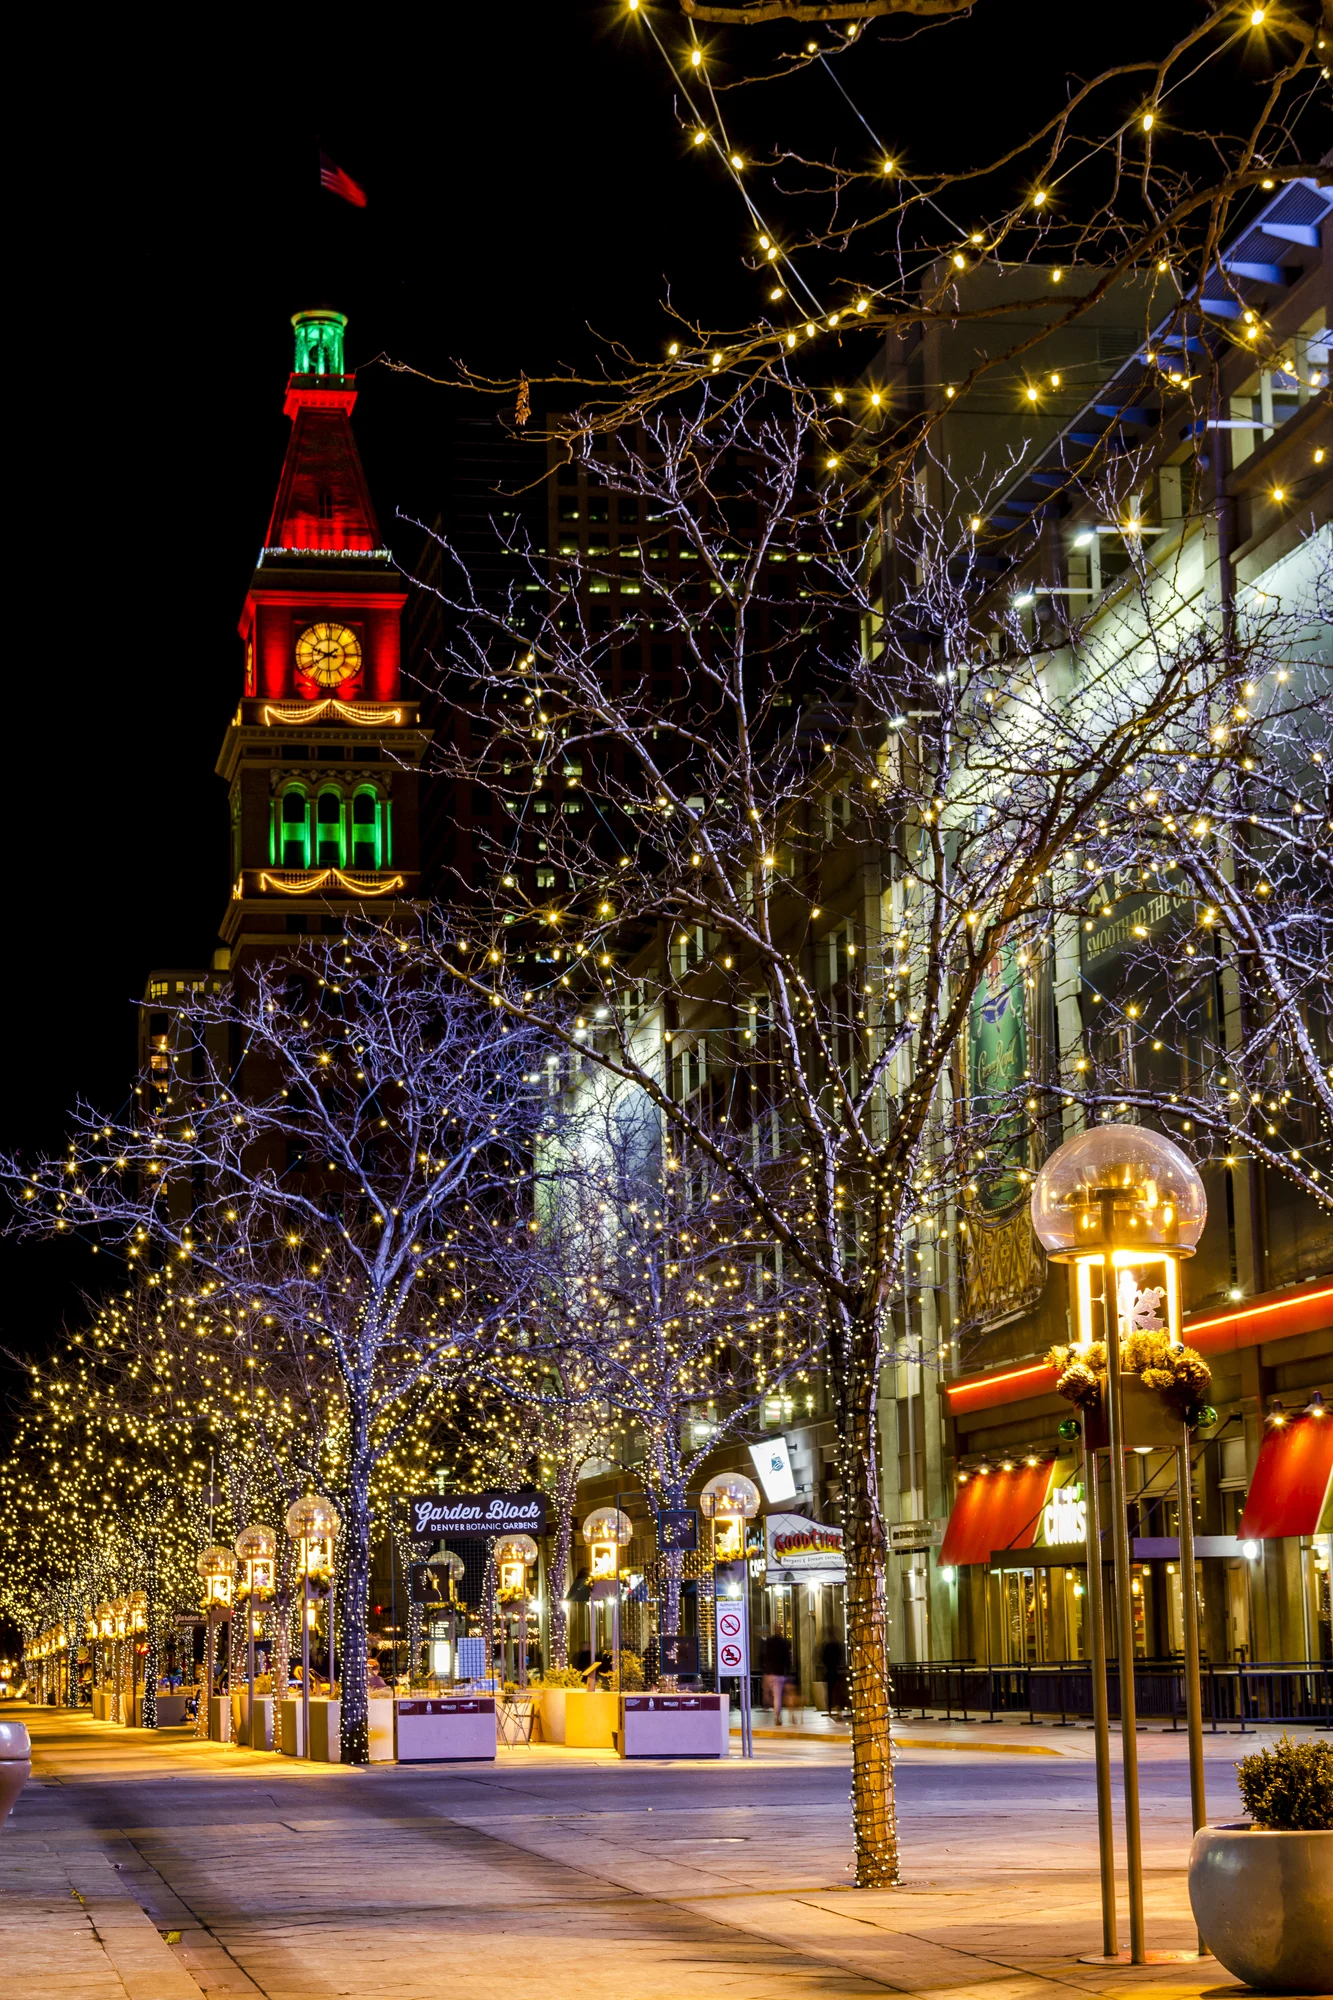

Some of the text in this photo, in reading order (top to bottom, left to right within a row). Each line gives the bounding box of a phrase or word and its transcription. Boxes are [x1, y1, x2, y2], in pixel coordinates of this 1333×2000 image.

[1086, 916, 1130, 962] SMOOTH
[1147, 894, 1172, 924] THE
[415, 1499, 541, 1533] Garden Block
[430, 1521, 538, 1532] DENVER BOTANIC GARDENS
[174, 1613, 199, 1626] Garden
